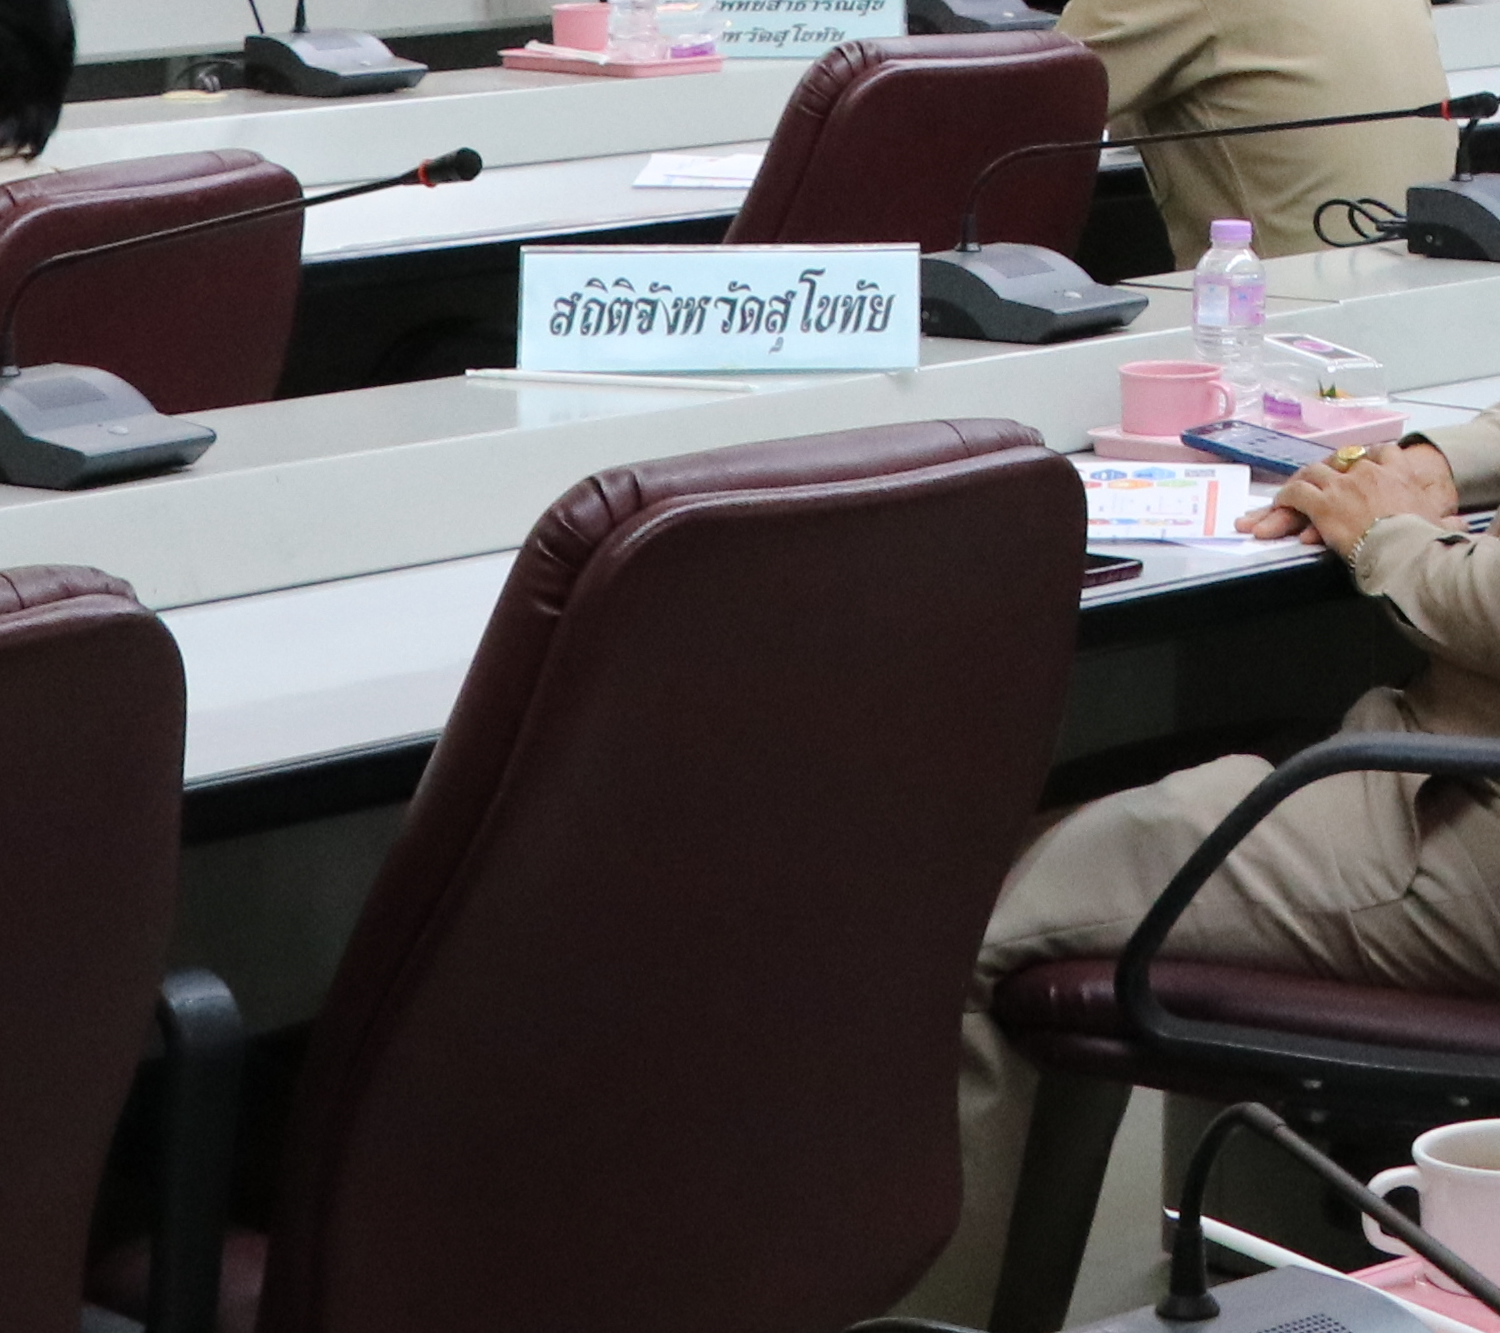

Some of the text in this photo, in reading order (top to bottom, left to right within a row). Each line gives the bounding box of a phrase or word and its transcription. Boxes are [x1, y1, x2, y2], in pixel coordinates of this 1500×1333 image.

[722, 23, 846, 49] หวัดสุโขทัย
